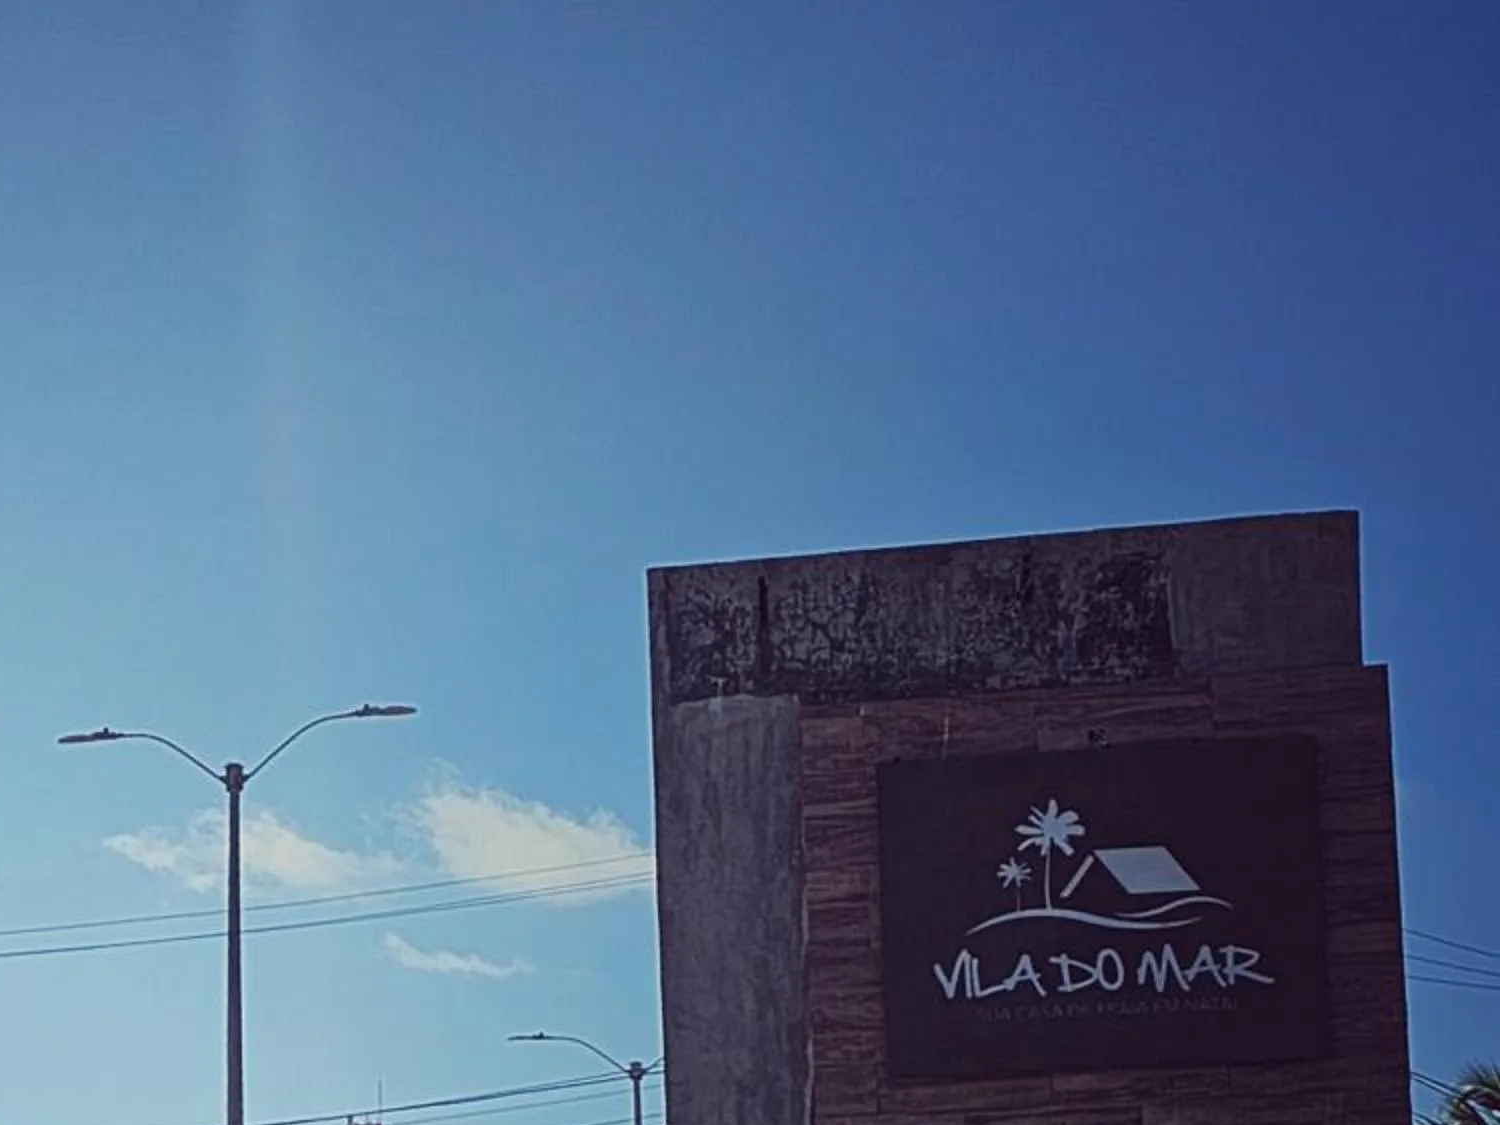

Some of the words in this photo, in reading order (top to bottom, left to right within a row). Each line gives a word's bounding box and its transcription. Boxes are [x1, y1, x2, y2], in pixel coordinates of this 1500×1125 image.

[933, 948, 1047, 999] VILA
[1049, 948, 1124, 992] DO
[1137, 944, 1275, 993] MAR
